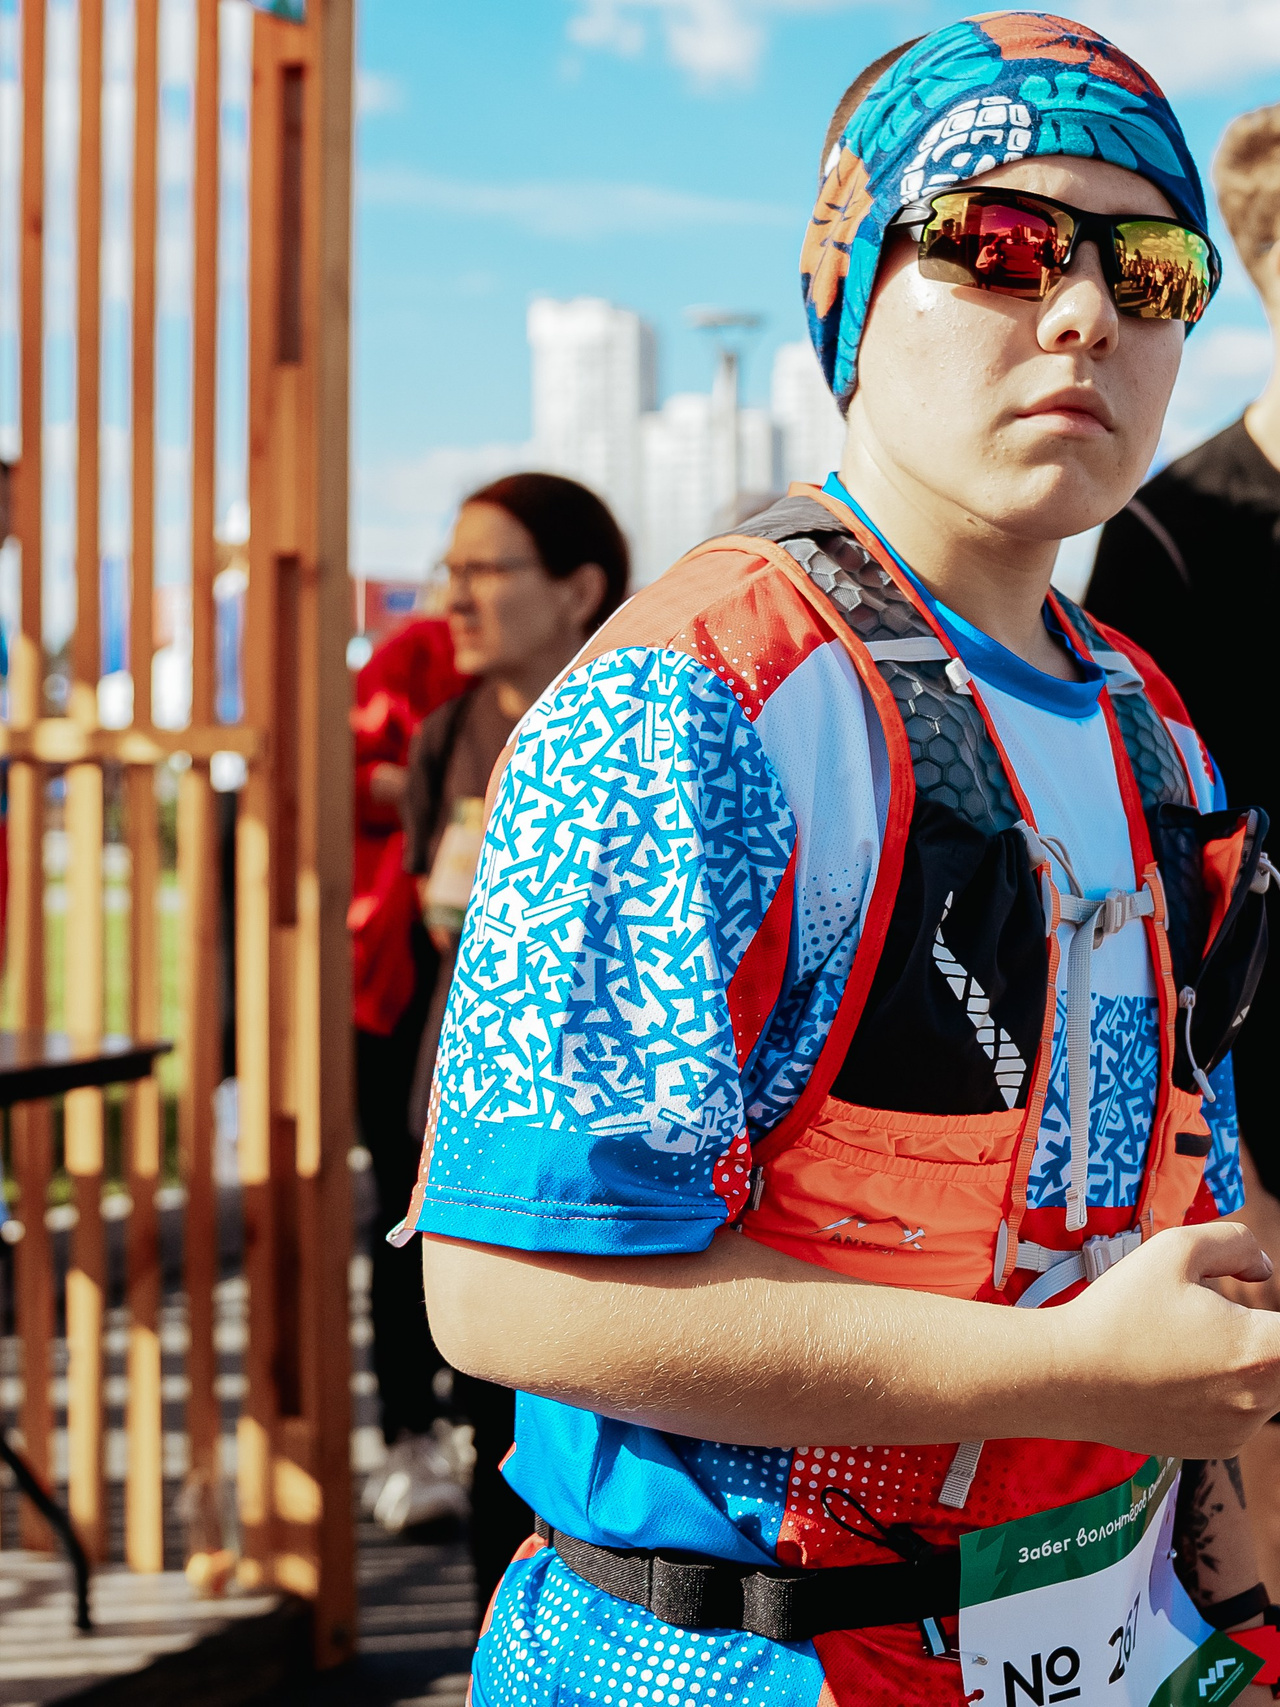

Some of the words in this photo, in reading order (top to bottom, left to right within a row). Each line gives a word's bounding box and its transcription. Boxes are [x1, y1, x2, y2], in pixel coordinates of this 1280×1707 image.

[1018, 1538, 1071, 1564] Забег
[1076, 1489, 1147, 1549] волонтёров
[1108, 1591, 1141, 1685] 267
